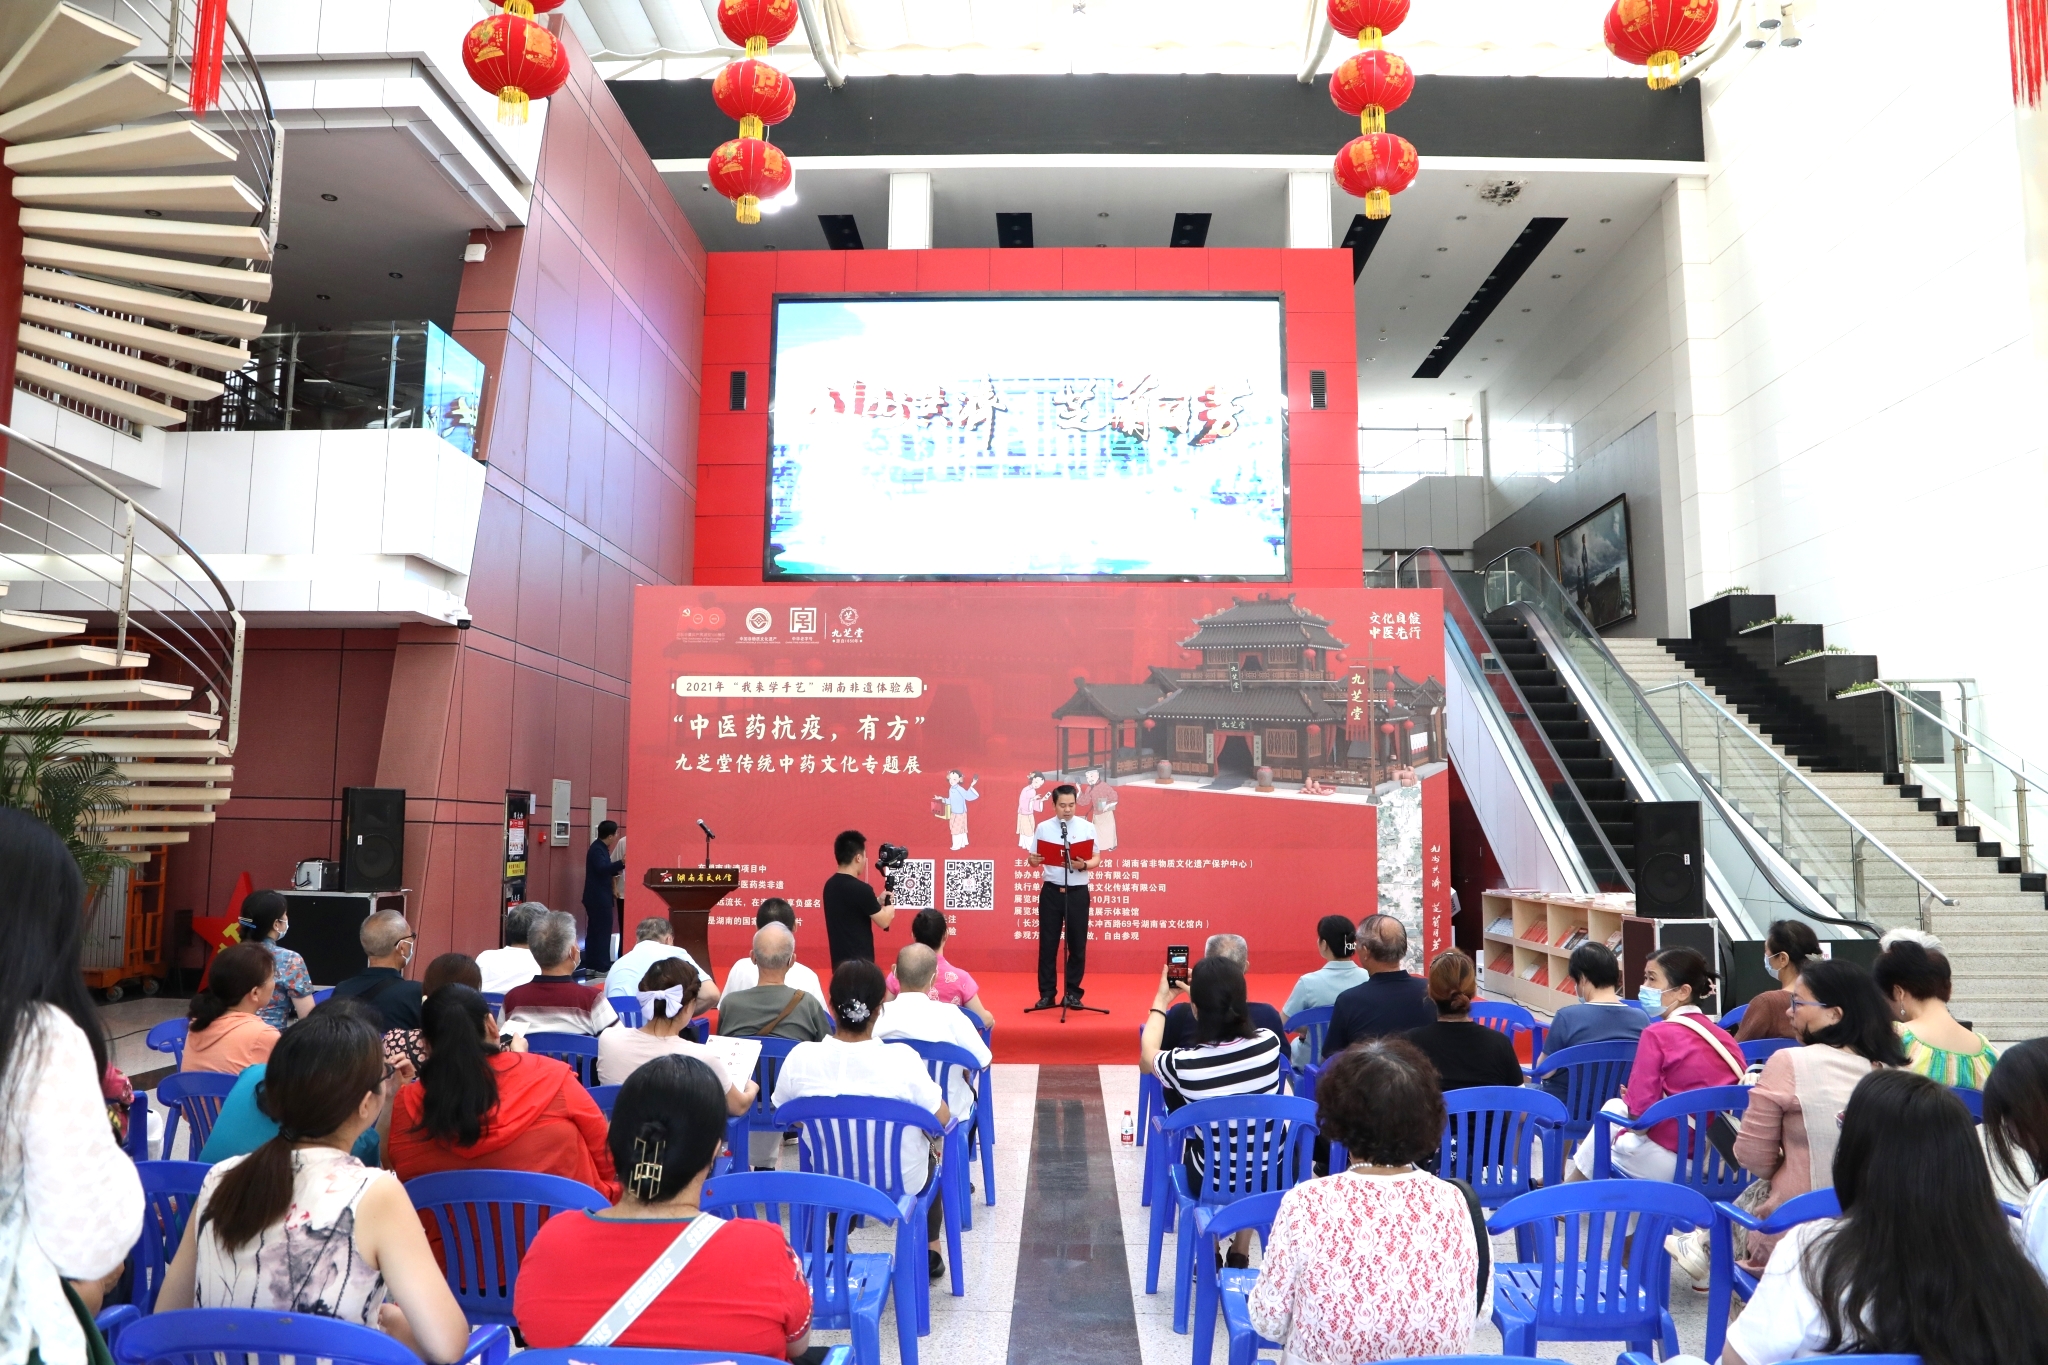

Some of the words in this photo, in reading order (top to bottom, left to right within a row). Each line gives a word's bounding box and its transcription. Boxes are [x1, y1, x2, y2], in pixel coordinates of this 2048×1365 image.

[831, 627, 864, 638] 九芝堂
[1368, 626, 1422, 640] 中医先行
[1230, 665, 1240, 689] 九芝堂
[1350, 672, 1366, 721] 九芝堂
[673, 713, 925, 742] “中医药抗疫，有方”
[1221, 720, 1246, 730] 九芝堂
[675, 753, 922, 775] 九芝堂传统中药文化专题展
[1014, 871, 1043, 880] 协办单
[739, 880, 785, 890] 医药类非遗
[1014, 882, 1042, 892] 执行单
[623, 1256, 675, 1317] SKECHERS
